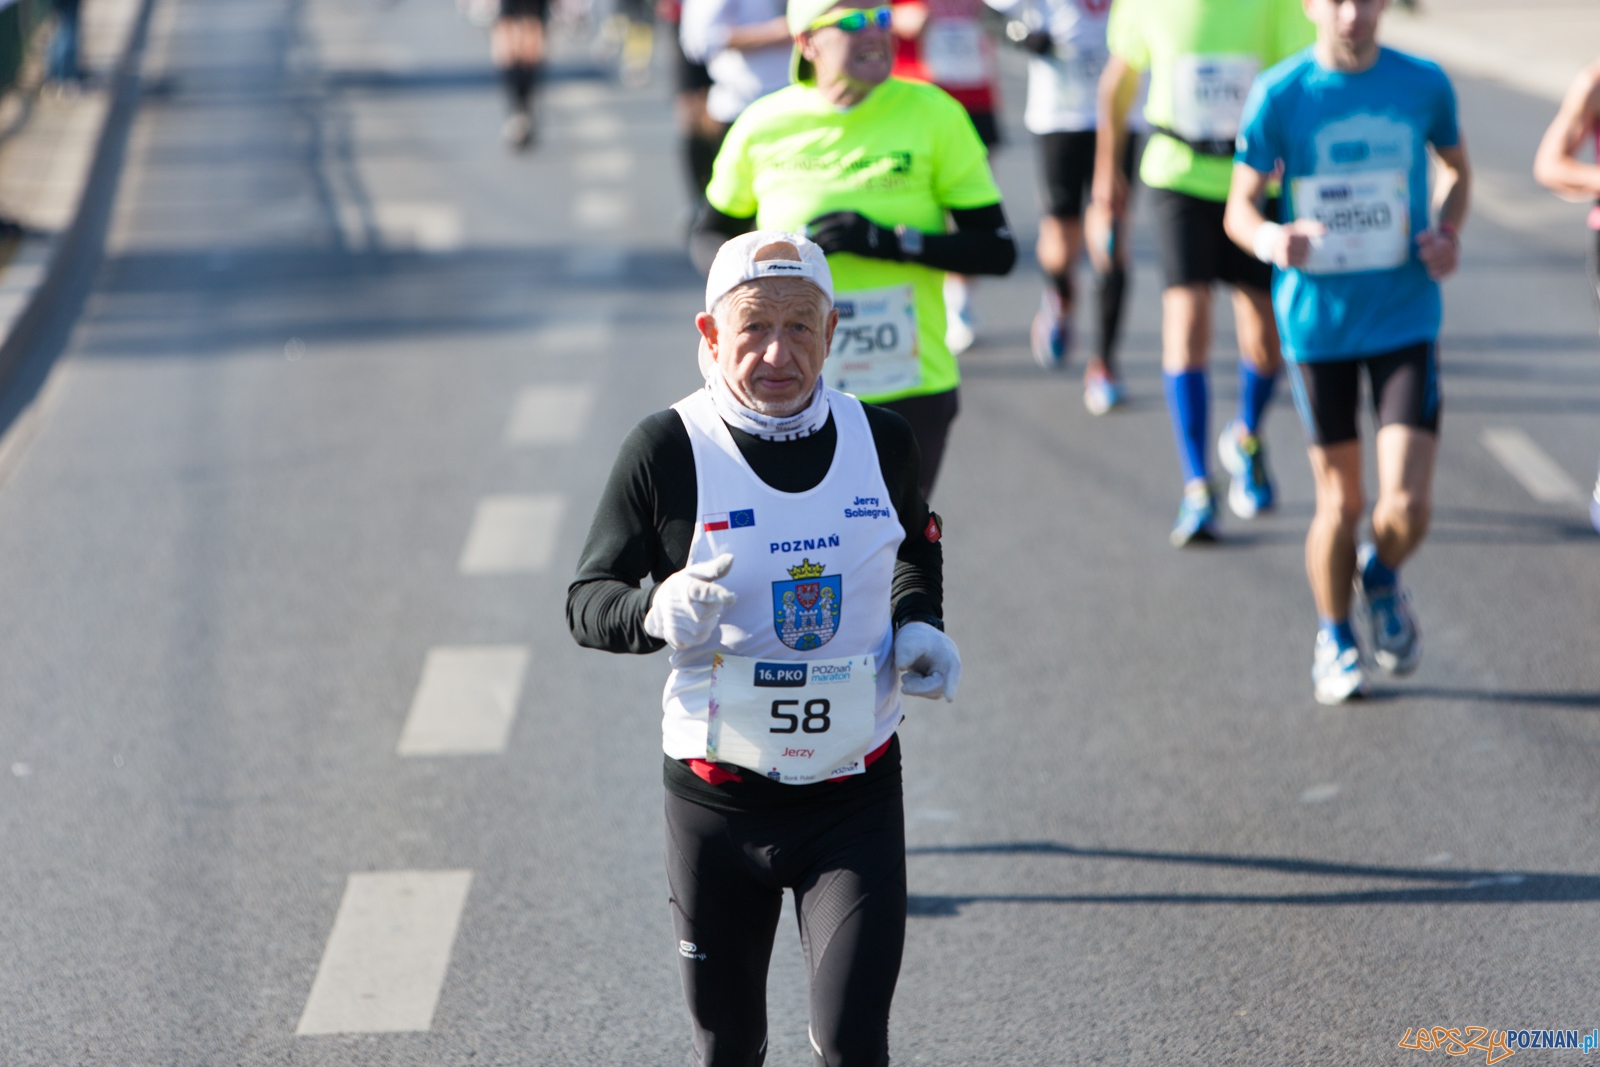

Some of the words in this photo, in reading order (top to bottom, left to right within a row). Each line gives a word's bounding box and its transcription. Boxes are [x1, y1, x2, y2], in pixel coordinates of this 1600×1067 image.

[853, 496, 879, 507] Jerzy
[844, 507, 890, 519] Sobiegraj
[769, 533, 840, 554] POZNAŃ
[758, 669, 776, 681] 16.
[777, 669, 803, 681] PKO
[811, 672, 851, 683] maraton
[769, 698, 831, 735] 58
[781, 747, 815, 759] Jerzy
